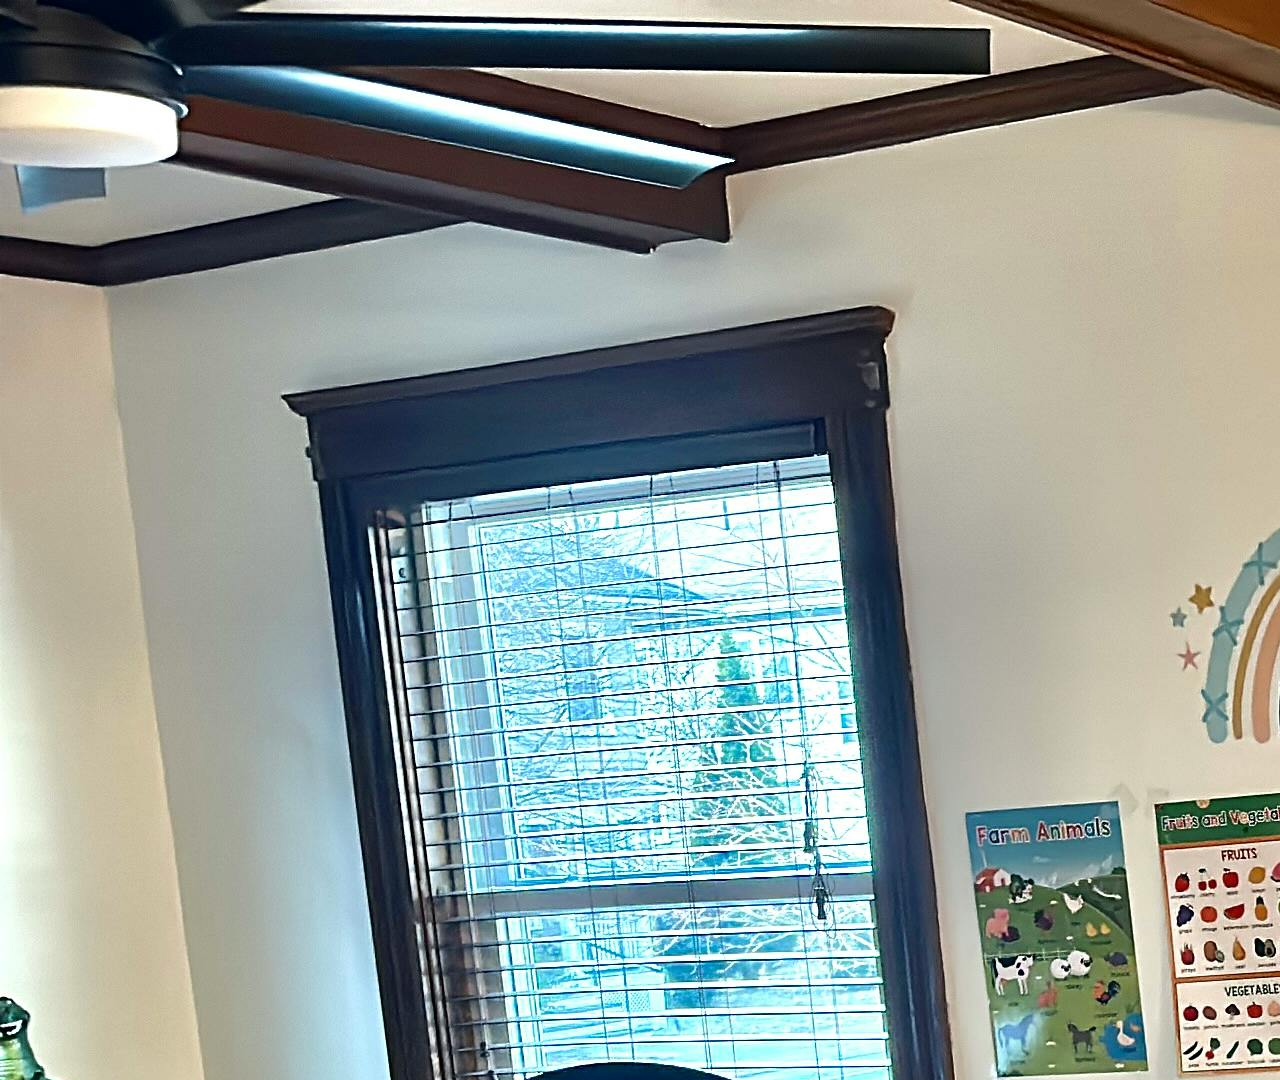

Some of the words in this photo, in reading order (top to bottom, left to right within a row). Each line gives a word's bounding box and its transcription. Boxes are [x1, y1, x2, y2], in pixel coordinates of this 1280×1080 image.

[1161, 814, 1200, 831] Fruits
[1202, 810, 1228, 827] and
[975, 825, 1030, 847] Farm
[1036, 816, 1111, 842] Animals
[1221, 847, 1258, 862] FRUITS
